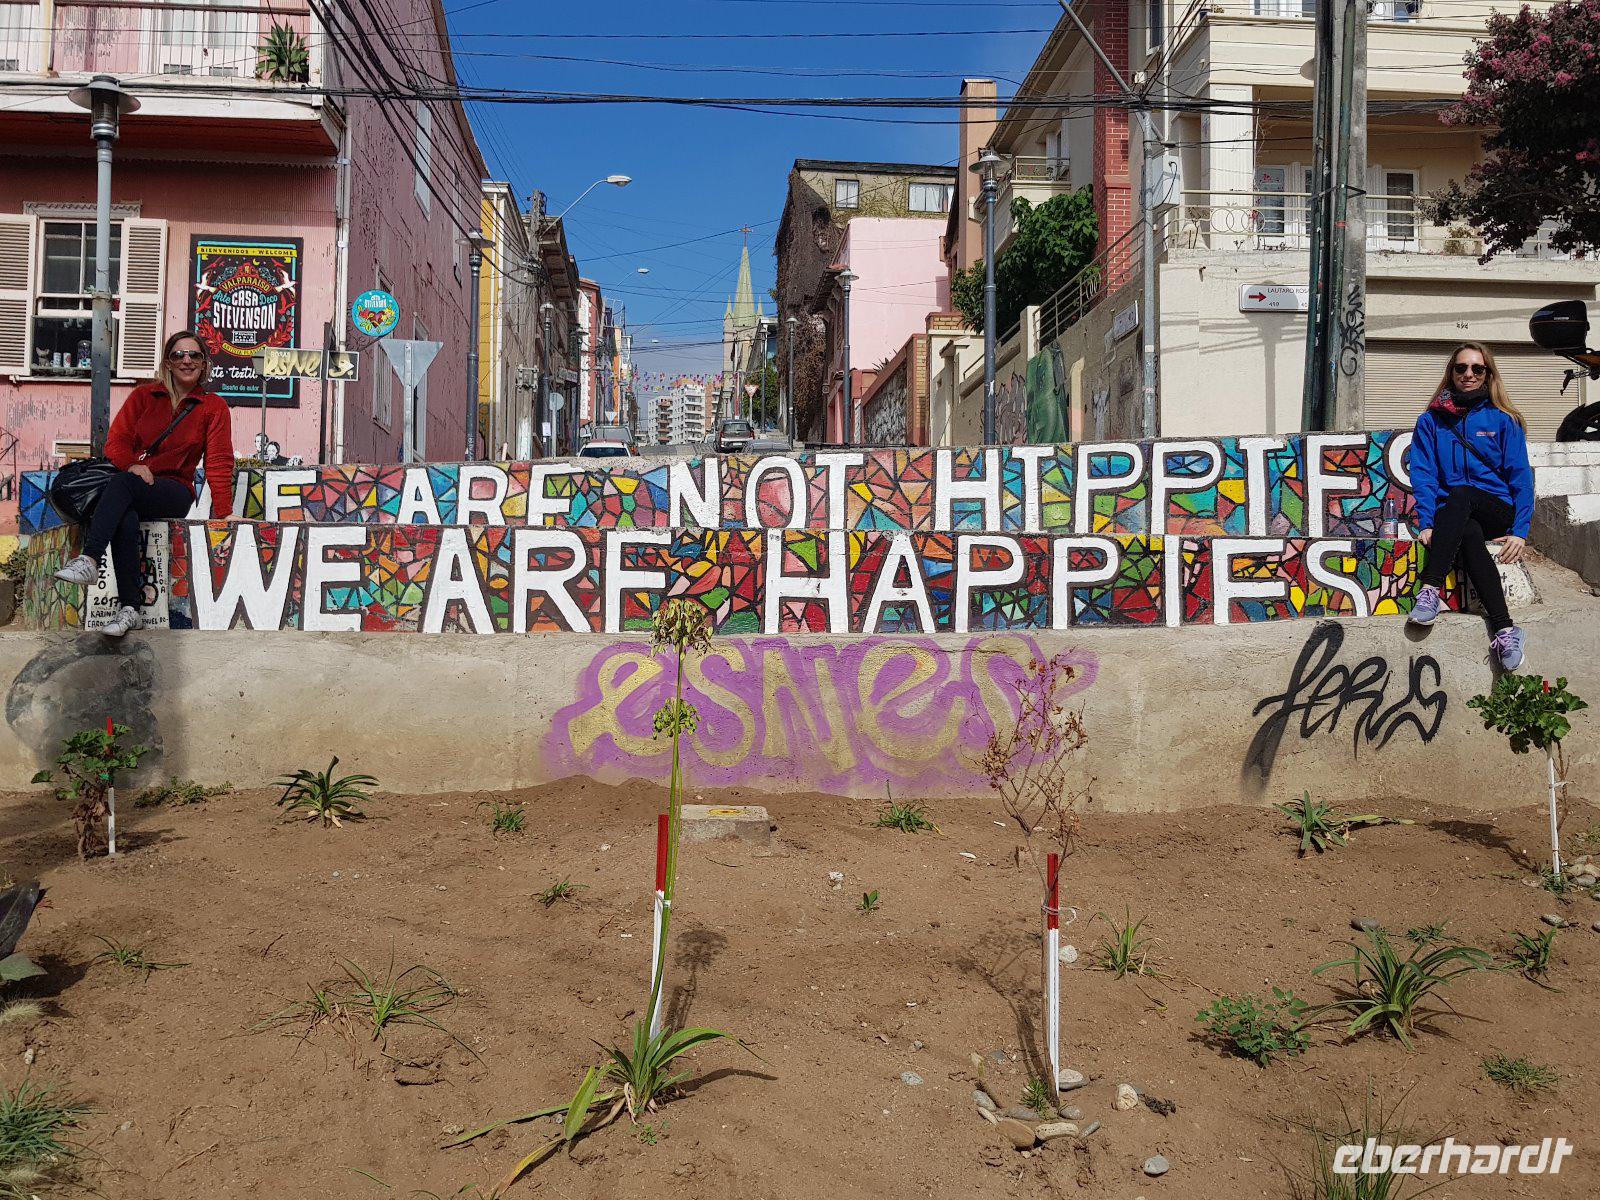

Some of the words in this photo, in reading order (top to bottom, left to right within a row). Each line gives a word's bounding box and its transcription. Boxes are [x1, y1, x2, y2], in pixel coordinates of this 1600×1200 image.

[200, 247, 249, 255] BIENVENIDOS
[222, 276, 270, 291] VALPARAISO
[232, 290, 258, 306] CASA
[213, 301, 277, 330] STEVENSON
[398, 462, 588, 525] ARE
[669, 451, 865, 529] NOT
[189, 524, 369, 633] WE
[422, 526, 671, 635] ARE
[764, 529, 1369, 635] HAPPIES
[93, 596, 119, 608] 2017
